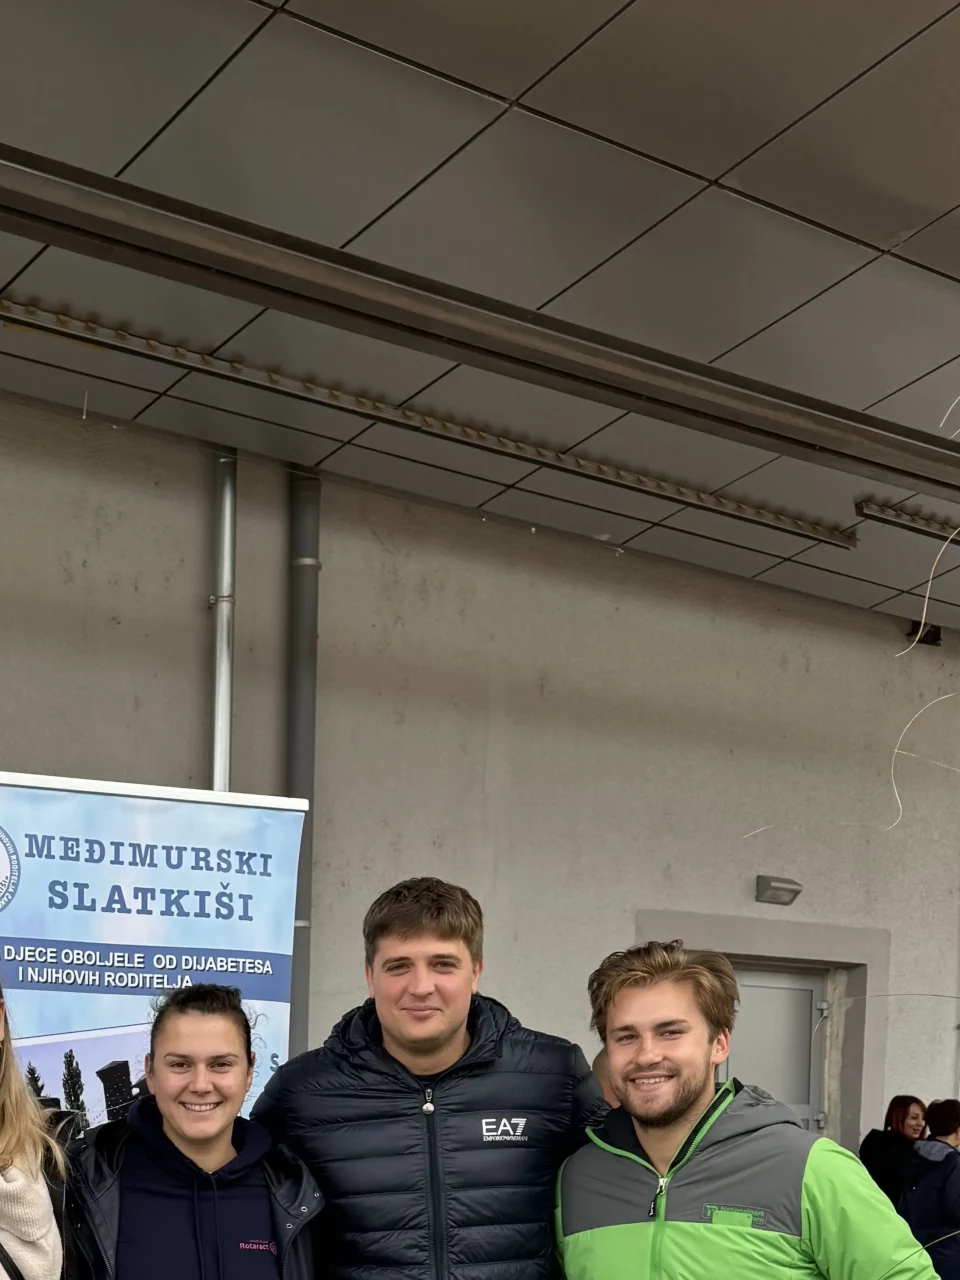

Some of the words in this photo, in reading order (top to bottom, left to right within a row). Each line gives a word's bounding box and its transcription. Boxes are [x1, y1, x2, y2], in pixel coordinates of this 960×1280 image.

[24, 833, 272, 878] MEĐIMURSKI
[48, 880, 254, 921] SLATKIŠI
[3, 946, 58, 964] DJECE
[61, 948, 145, 969] OBOLJELE
[153, 954, 177, 969] OD
[181, 955, 273, 975] DIJABETESA
[18, 966, 23, 981] I
[27, 967, 100, 986] NJIHOVIH
[104, 972, 194, 989] RODITELJA
[481, 1117, 528, 1136] EA7
[239, 1242, 269, 1250] Rotaract
